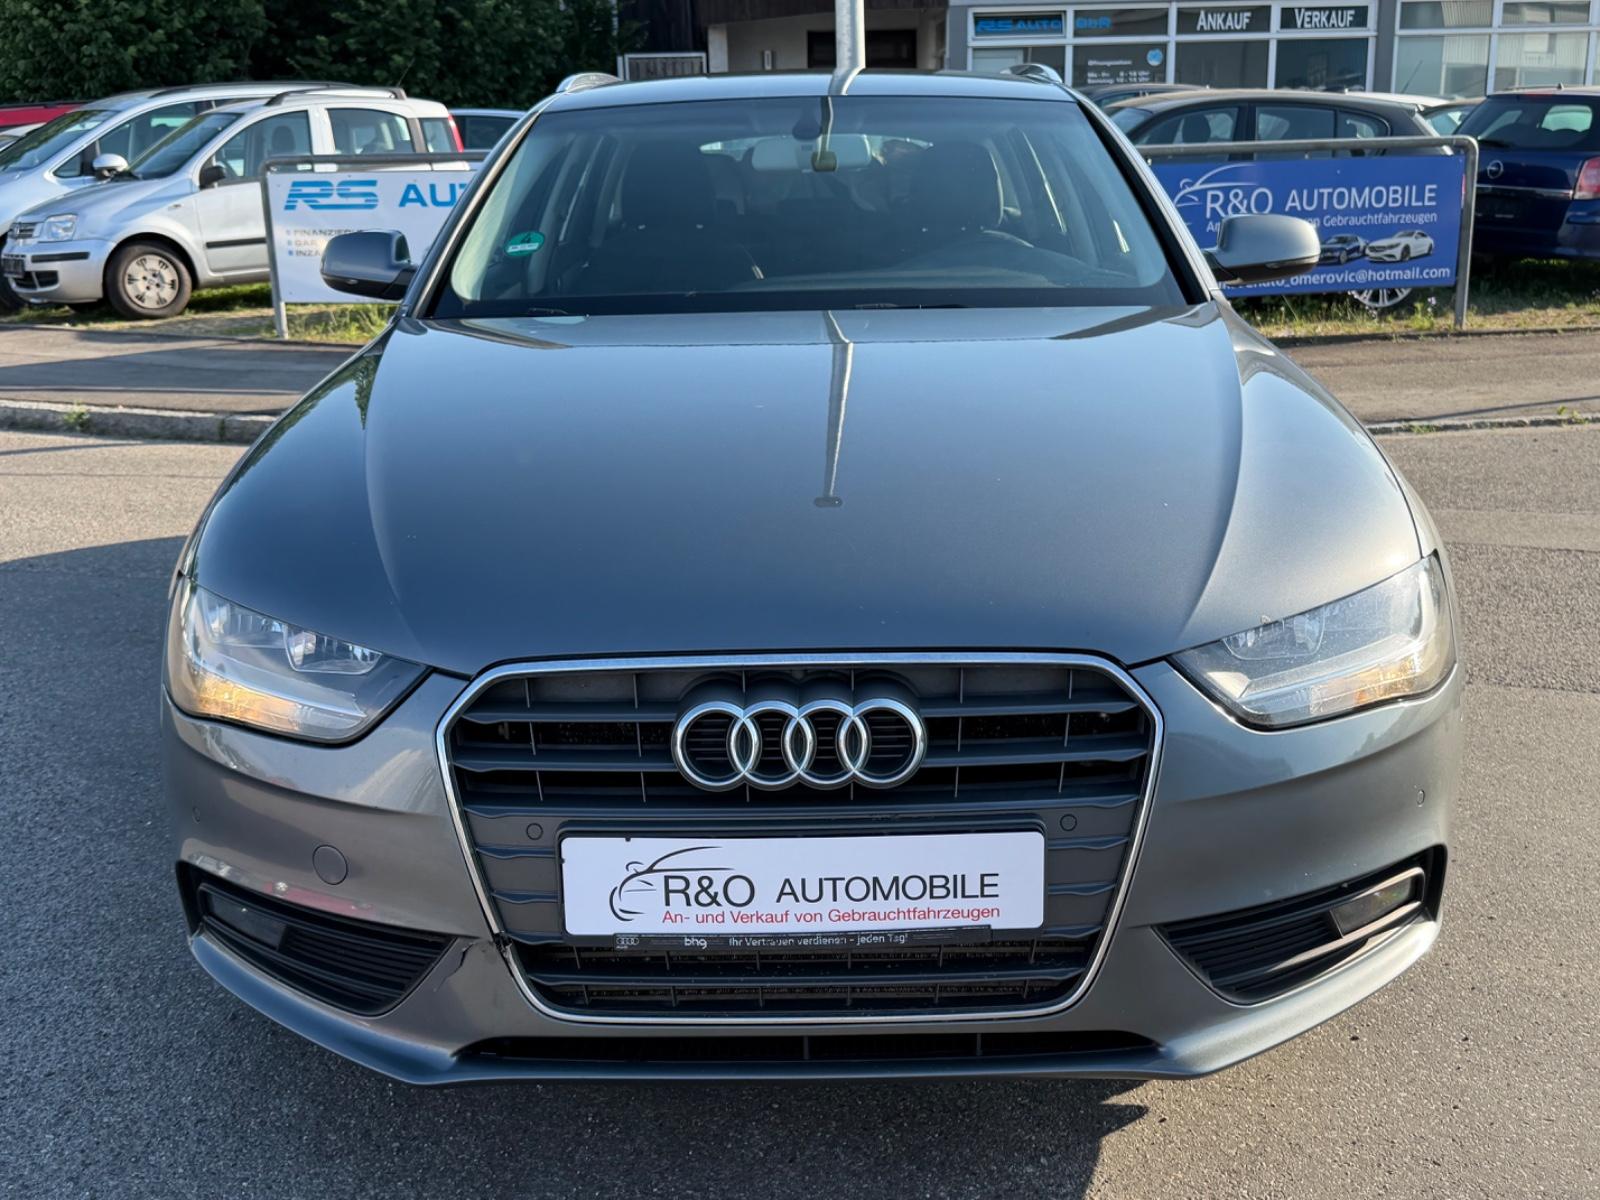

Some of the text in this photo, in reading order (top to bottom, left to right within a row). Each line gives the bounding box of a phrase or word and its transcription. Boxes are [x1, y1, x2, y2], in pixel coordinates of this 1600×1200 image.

[1016, 19, 1061, 30] AUTO
[1196, 10, 1252, 31] ANKAUF
[1294, 8, 1355, 28] VERKAUF
[284, 180, 379, 211] RS
[1206, 184, 1438, 219] R&O AUTOMOBILE
[1323, 211, 1438, 227] Gebrauchtfahrzeugen
[663, 873, 1000, 907] R&O AUTOMOBILE
[662, 905, 1001, 924] An- und Verkauf von Gebrauchtfahrzeugen
[684, 937, 708, 949] bhg
